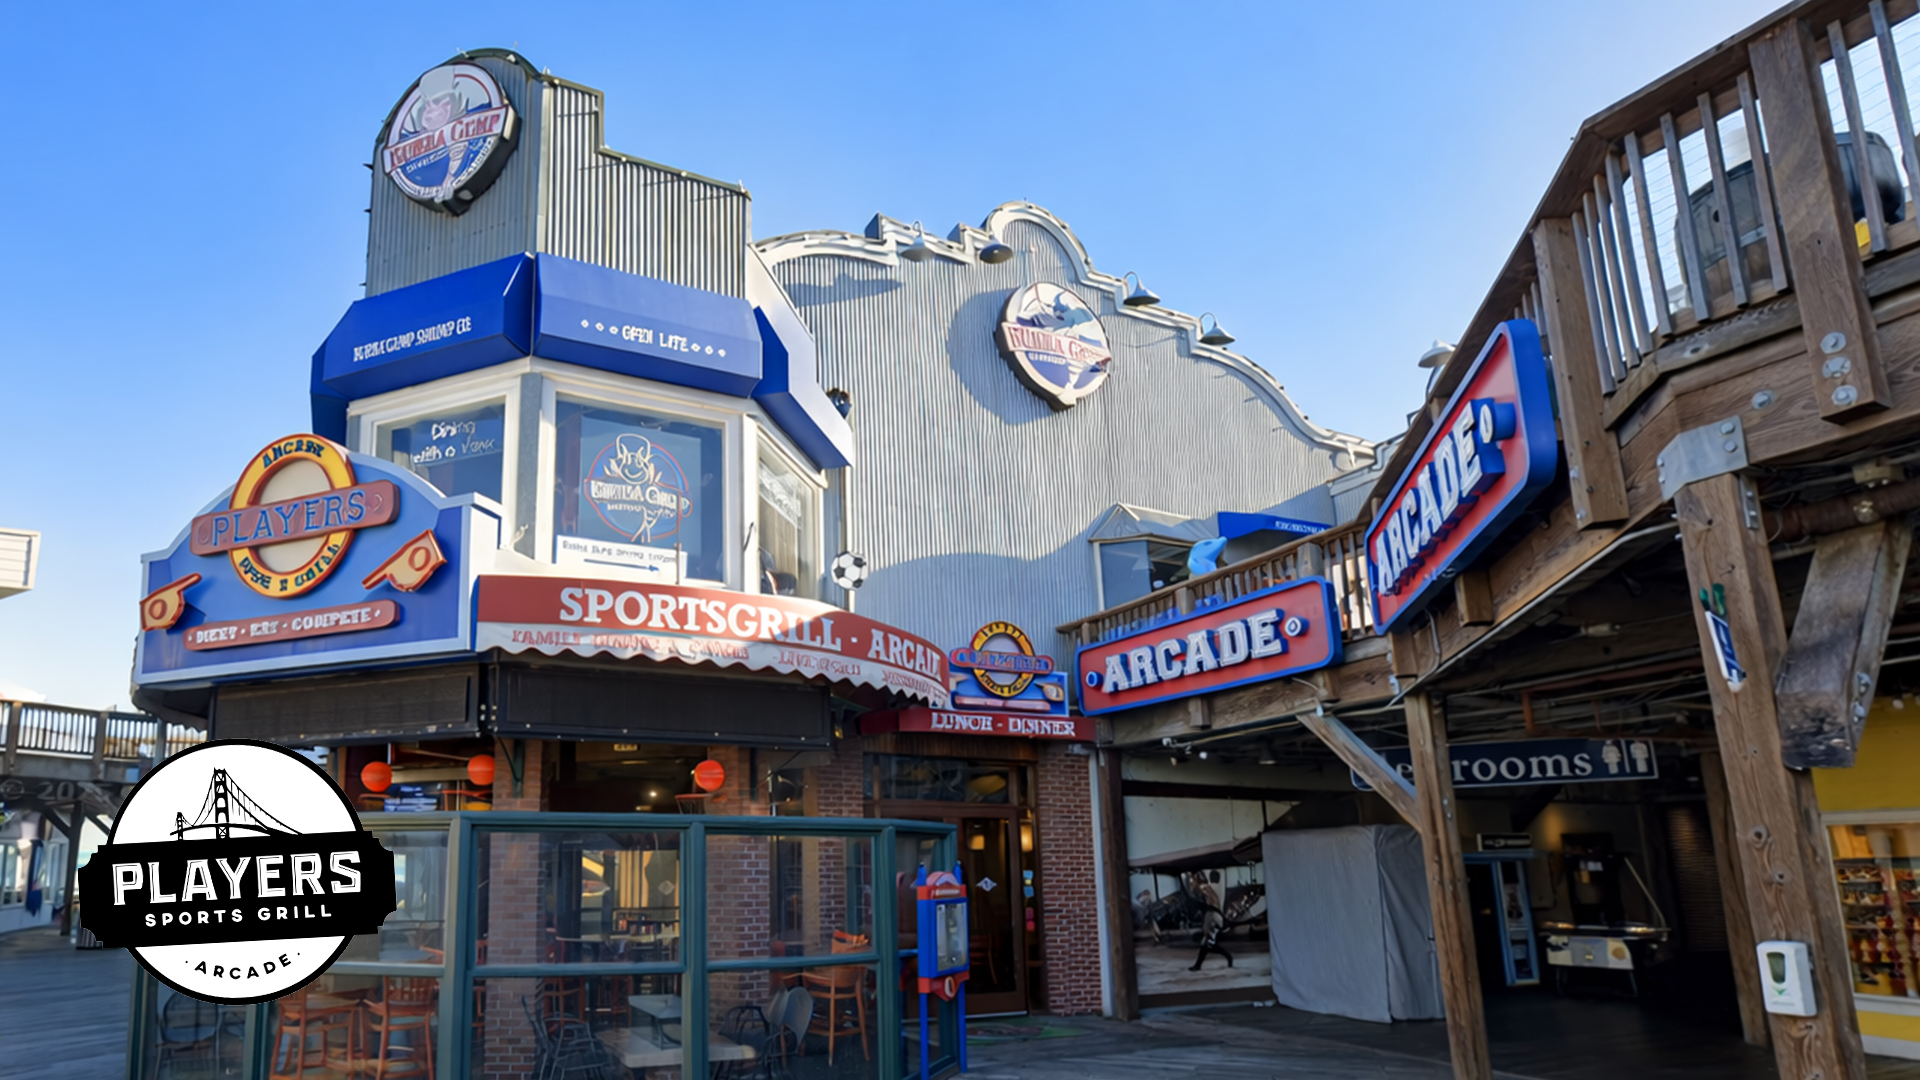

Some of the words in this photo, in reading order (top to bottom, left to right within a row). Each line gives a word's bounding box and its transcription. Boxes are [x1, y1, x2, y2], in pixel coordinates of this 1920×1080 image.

[212, 490, 366, 547] PLAYERS
[1375, 400, 1483, 596] ARCADE
[1101, 608, 1283, 694] ARCADE
